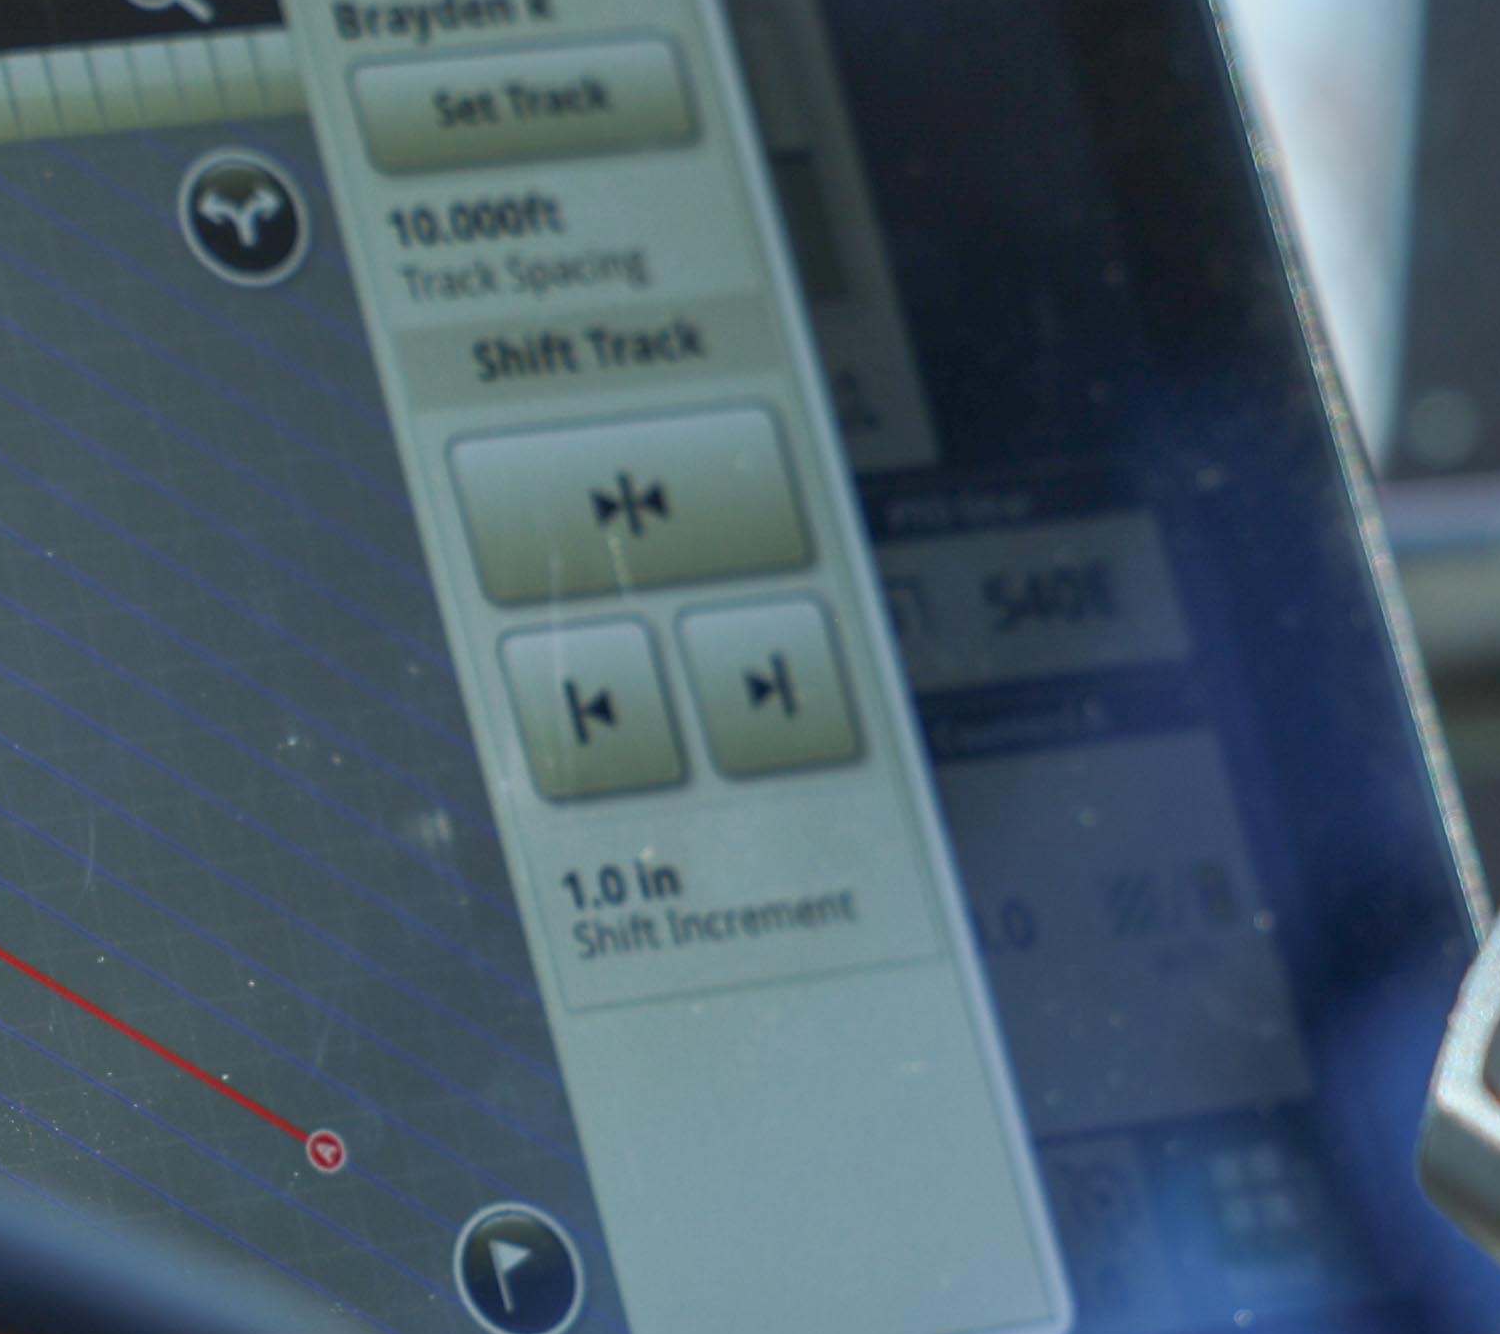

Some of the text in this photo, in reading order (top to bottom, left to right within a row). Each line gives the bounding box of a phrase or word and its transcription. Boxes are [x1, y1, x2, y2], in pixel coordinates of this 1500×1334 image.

[433, 74, 611, 128] Set Track
[401, 246, 652, 302] Track Spacing
[473, 312, 707, 382] Shift Track
[562, 858, 684, 910] 1.0 in
[572, 886, 859, 961] Shift Increment
